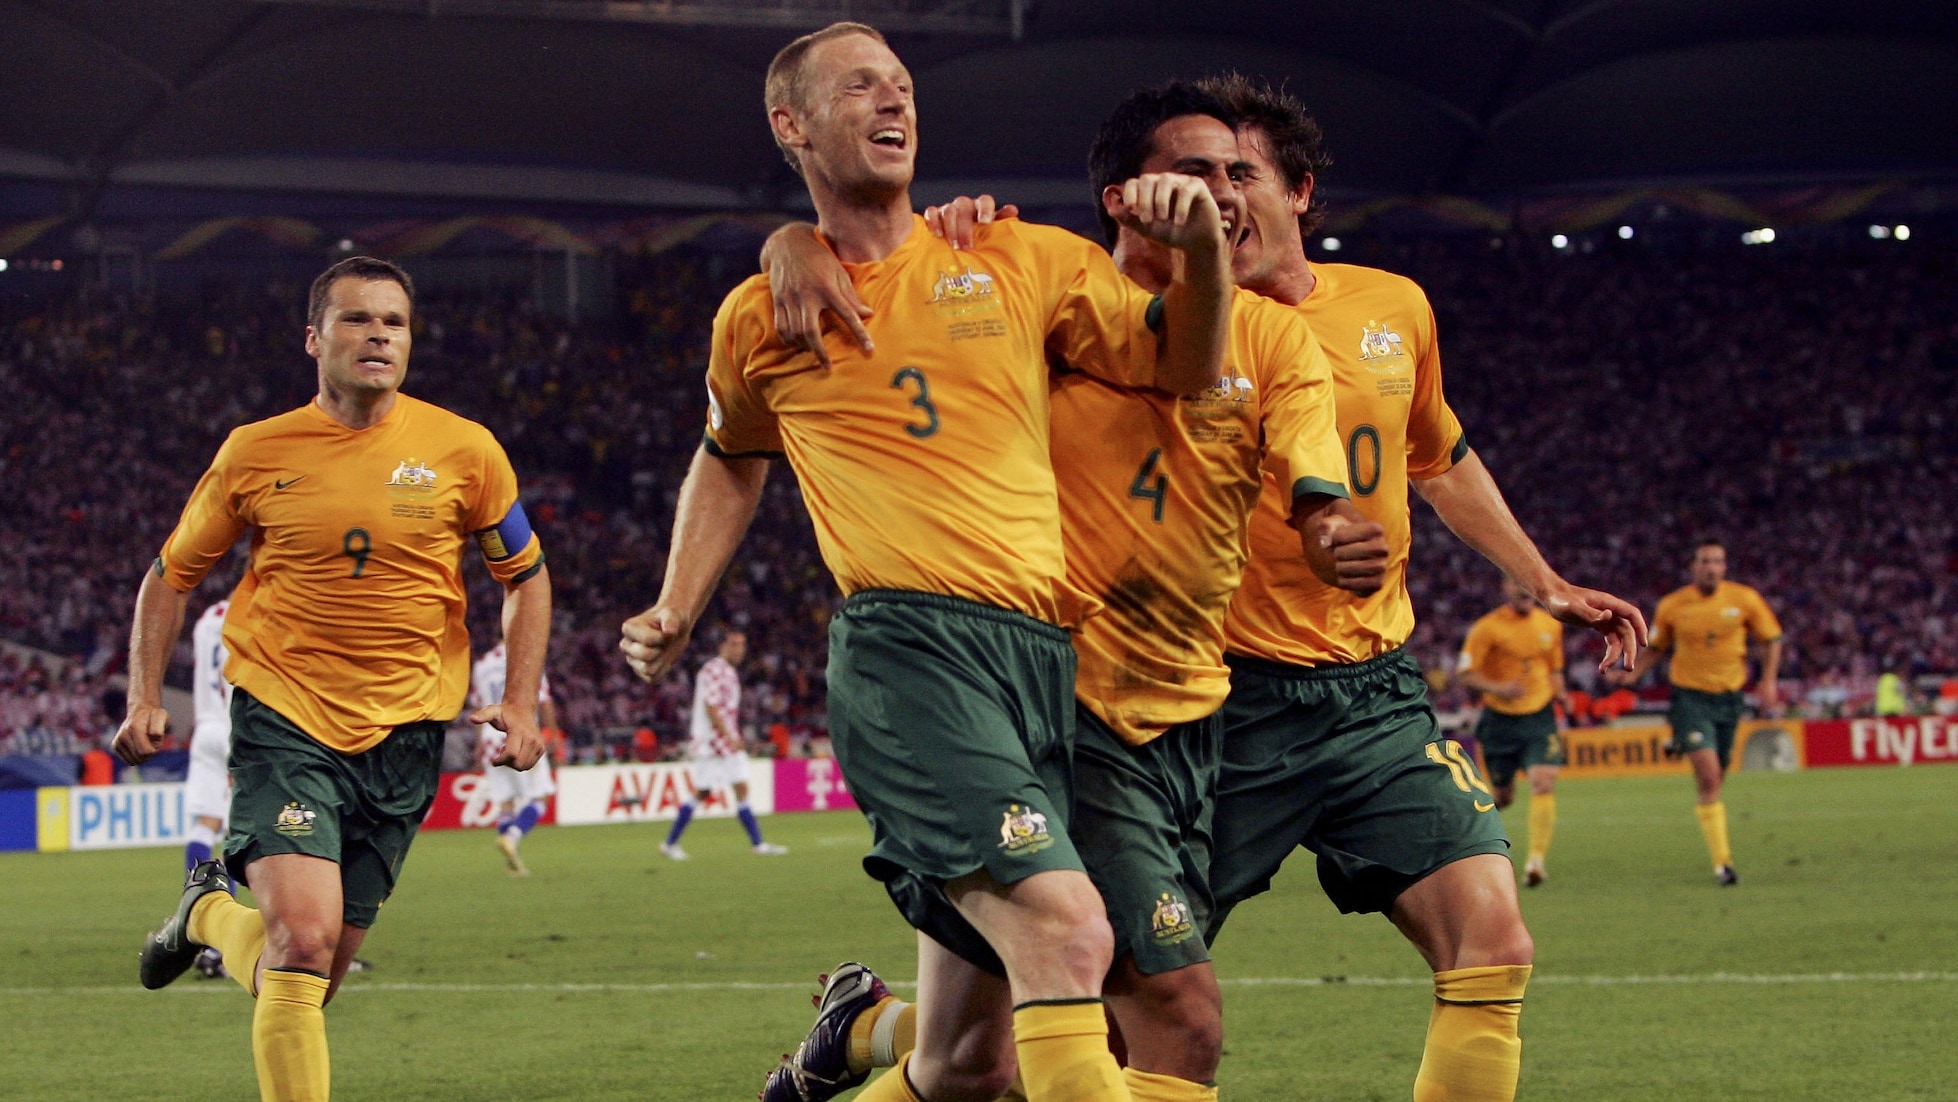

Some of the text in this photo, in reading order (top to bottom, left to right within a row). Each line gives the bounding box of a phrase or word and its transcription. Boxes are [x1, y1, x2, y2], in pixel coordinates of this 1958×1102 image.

[890, 366, 940, 438] 3
[1128, 446, 1169, 524] 4
[1348, 424, 1382, 497] 0
[344, 527, 372, 578] 9
[79, 791, 184, 841] PHILI
